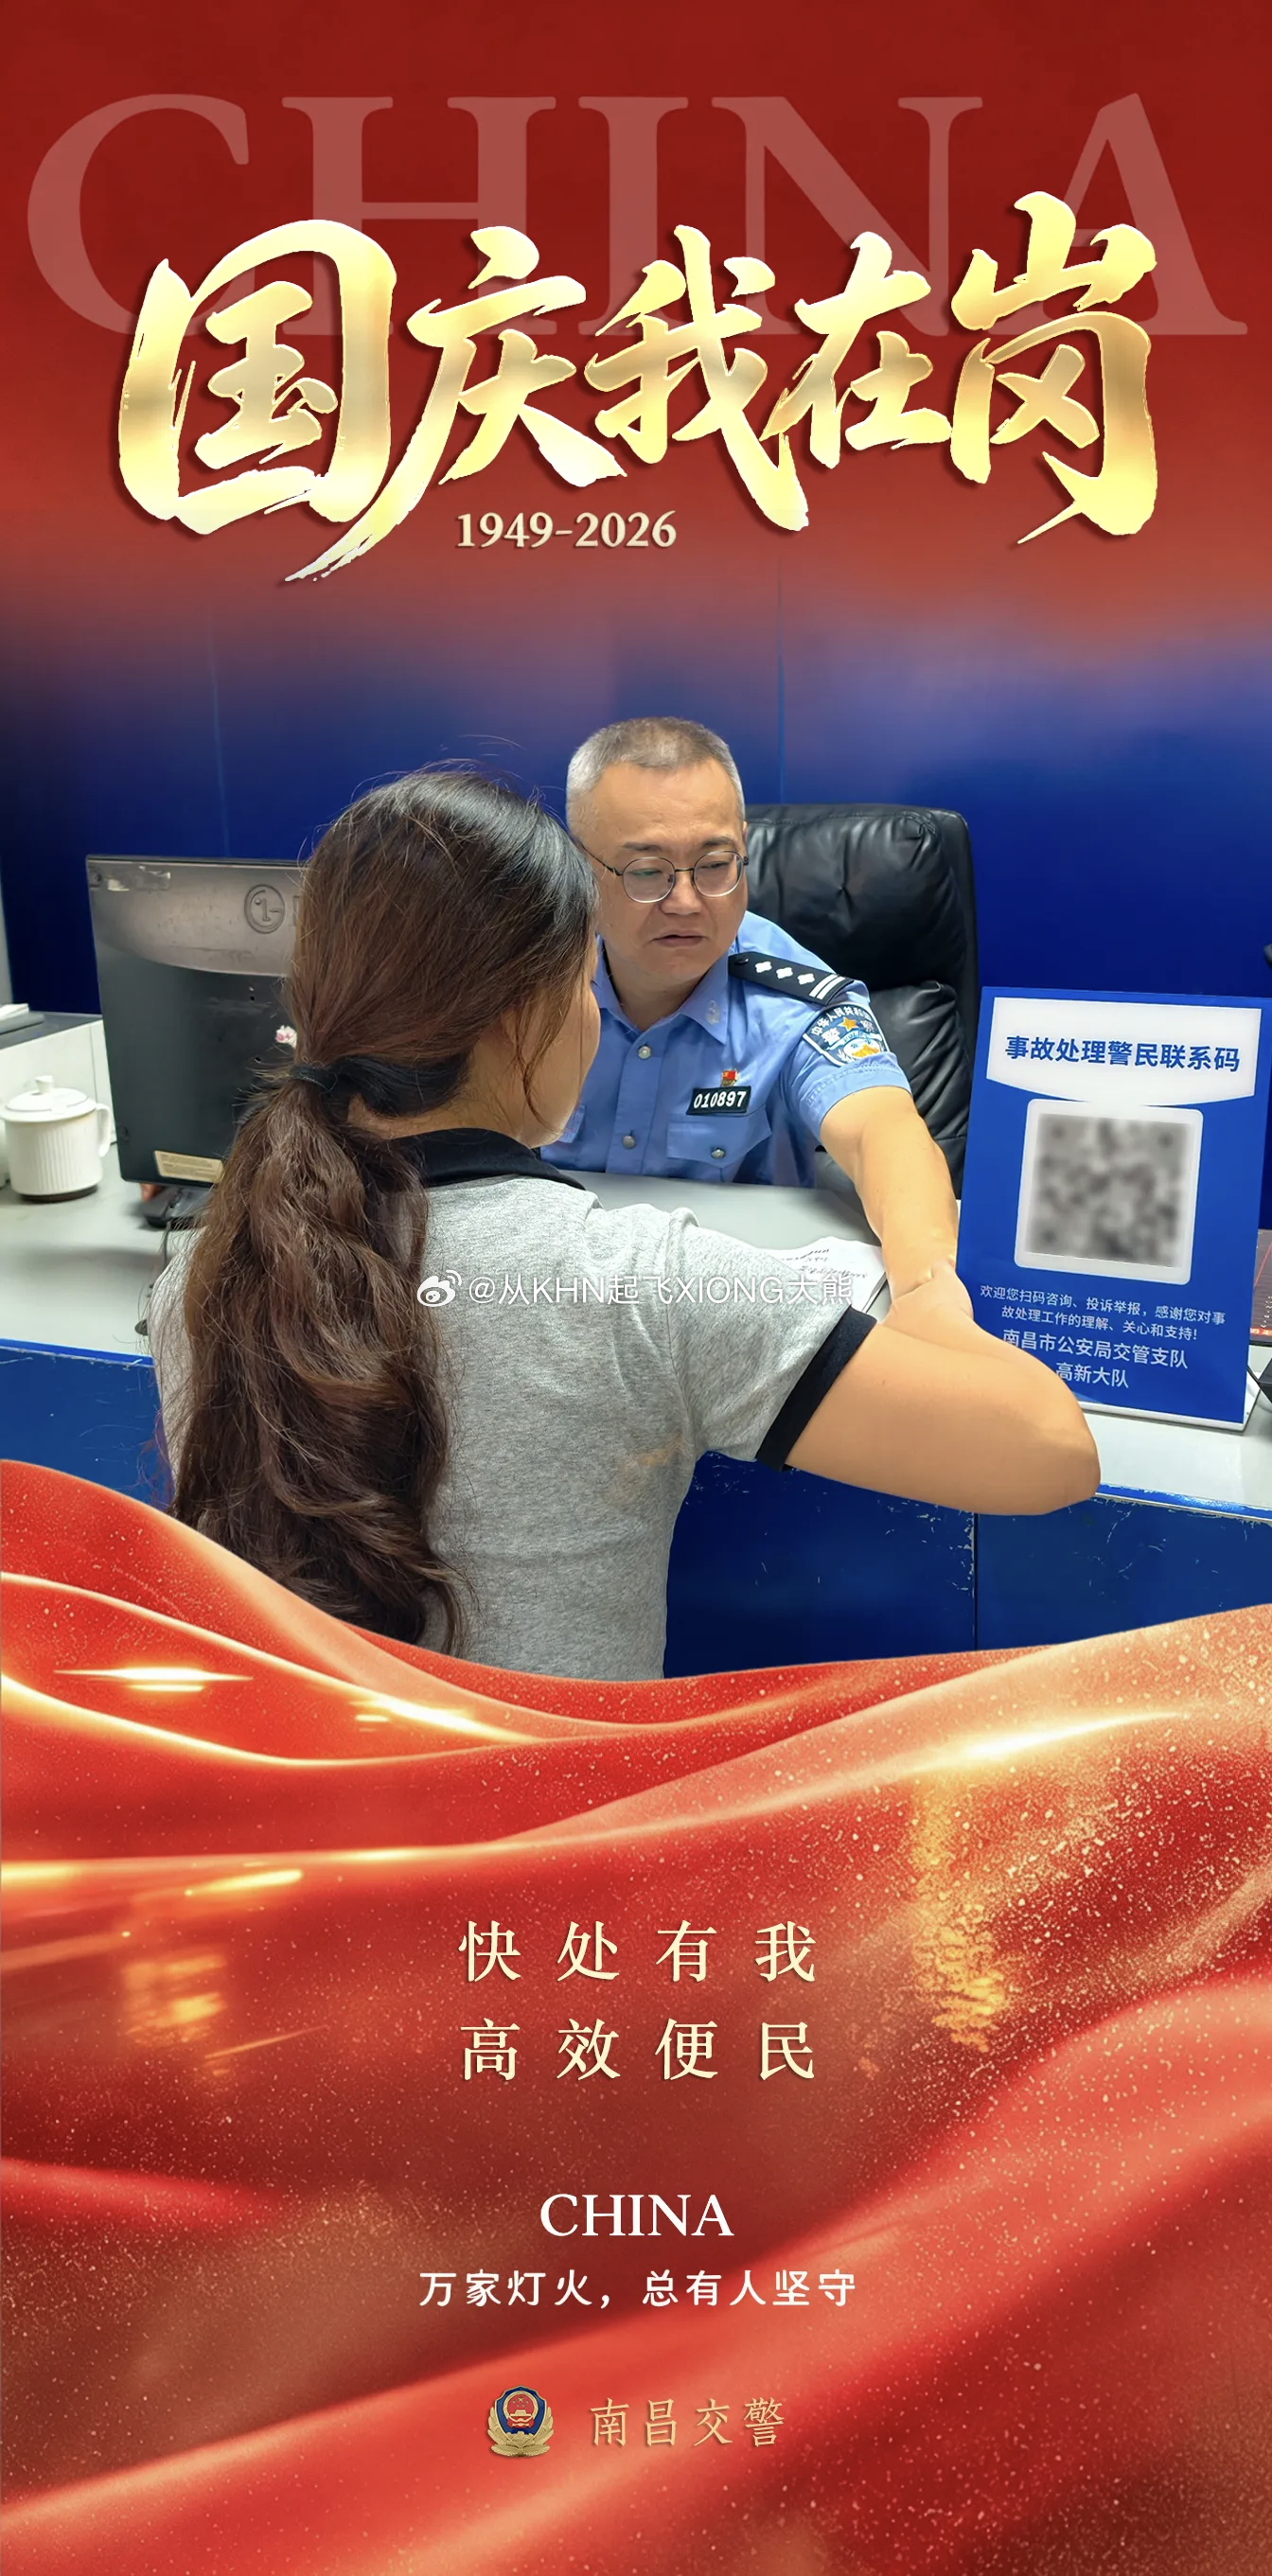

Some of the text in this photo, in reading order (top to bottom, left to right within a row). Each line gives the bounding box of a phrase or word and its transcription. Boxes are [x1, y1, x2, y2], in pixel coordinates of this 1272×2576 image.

[1005, 1034, 1241, 1073] 事故处理警民联系码
[693, 1090, 747, 1109] 010897
[980, 1284, 1227, 1326] 欢迎您扫码咨询、投诉举报，感谢您对事
[1002, 1329, 1189, 1369] 南昌市公安局交管支队
[1055, 1361, 1129, 1389] 高新大队
